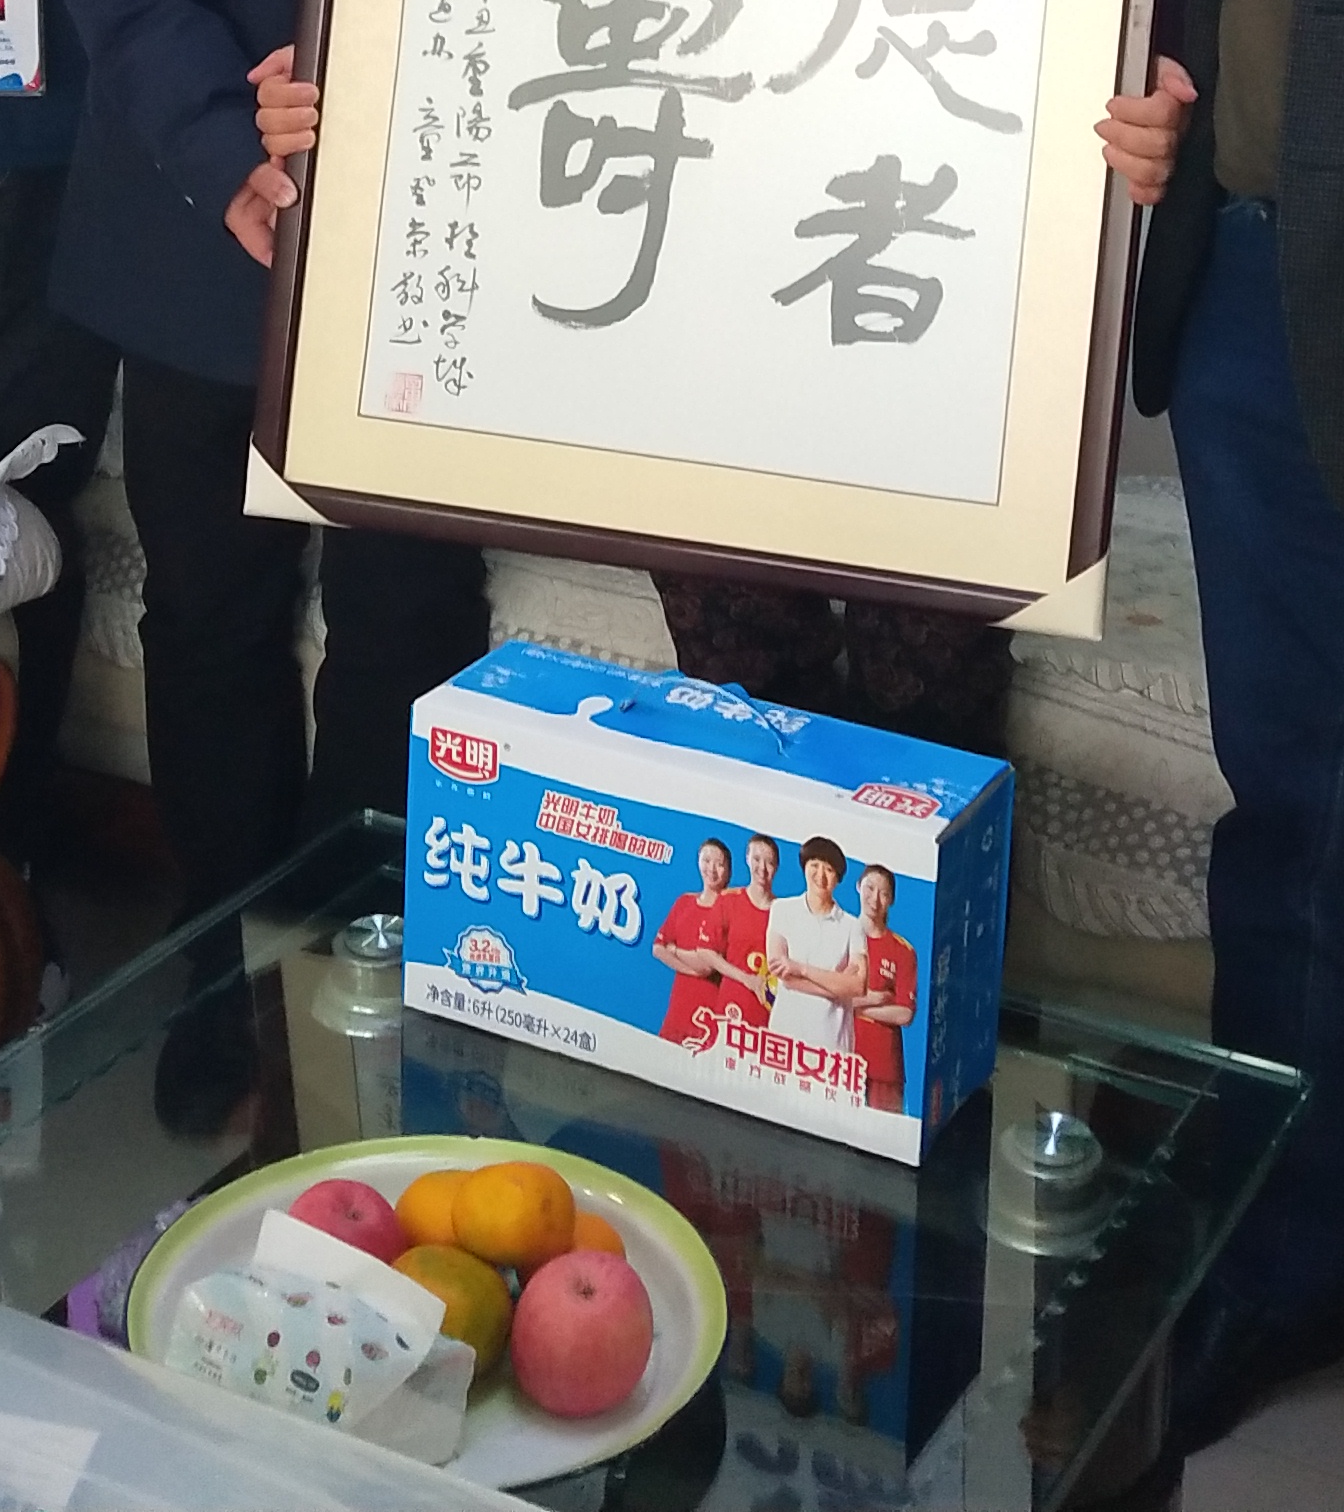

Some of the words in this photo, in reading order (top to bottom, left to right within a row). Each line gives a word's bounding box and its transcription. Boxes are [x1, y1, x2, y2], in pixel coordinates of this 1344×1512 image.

[434, 730, 493, 779] 光明
[423, 815, 643, 945] 纯牛奶
[726, 1020, 864, 1094] 中国女排
